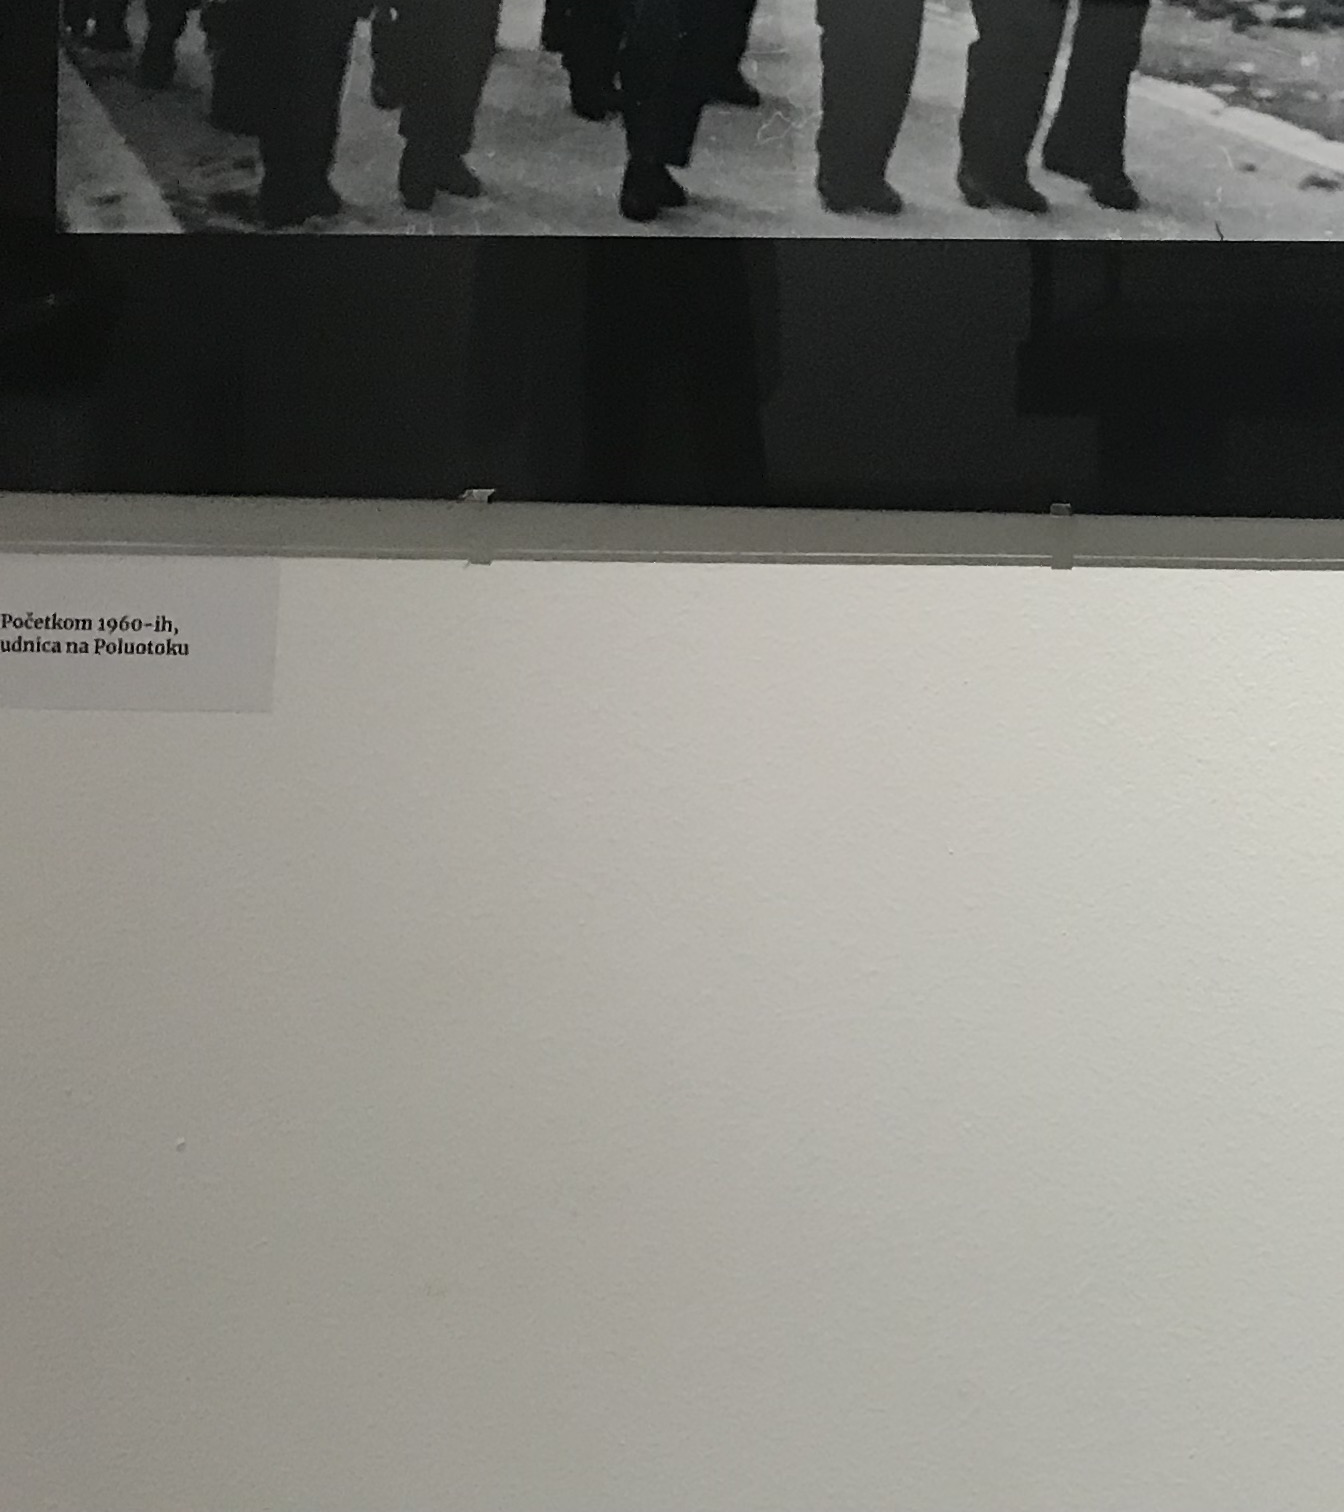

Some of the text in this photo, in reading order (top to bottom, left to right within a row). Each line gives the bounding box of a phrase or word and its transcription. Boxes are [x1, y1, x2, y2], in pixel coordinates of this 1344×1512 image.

[0, 611, 179, 636] Početkom 1960-ih,
[65, 641, 90, 655] na
[93, 637, 190, 656] Poluotoku
